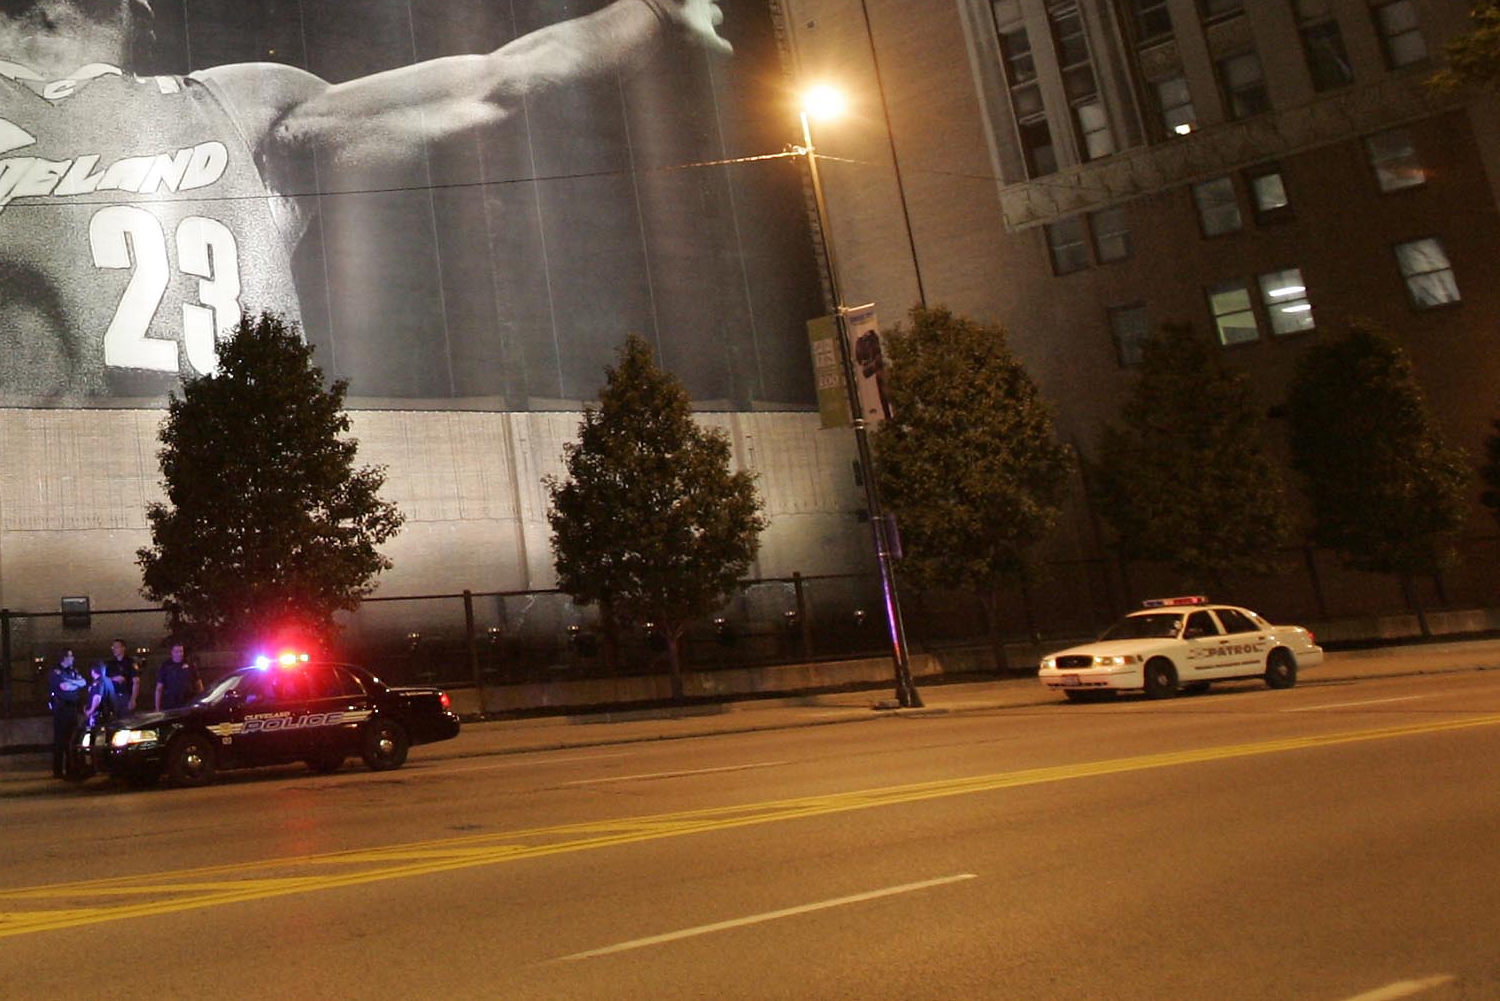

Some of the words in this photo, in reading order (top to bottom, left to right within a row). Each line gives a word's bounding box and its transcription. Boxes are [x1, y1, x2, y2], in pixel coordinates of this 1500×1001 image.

[88, 204, 243, 378] 23
[1208, 643, 1263, 657] PATROL
[240, 711, 345, 735] POLICE
[243, 711, 291, 721] CLEVELAND
